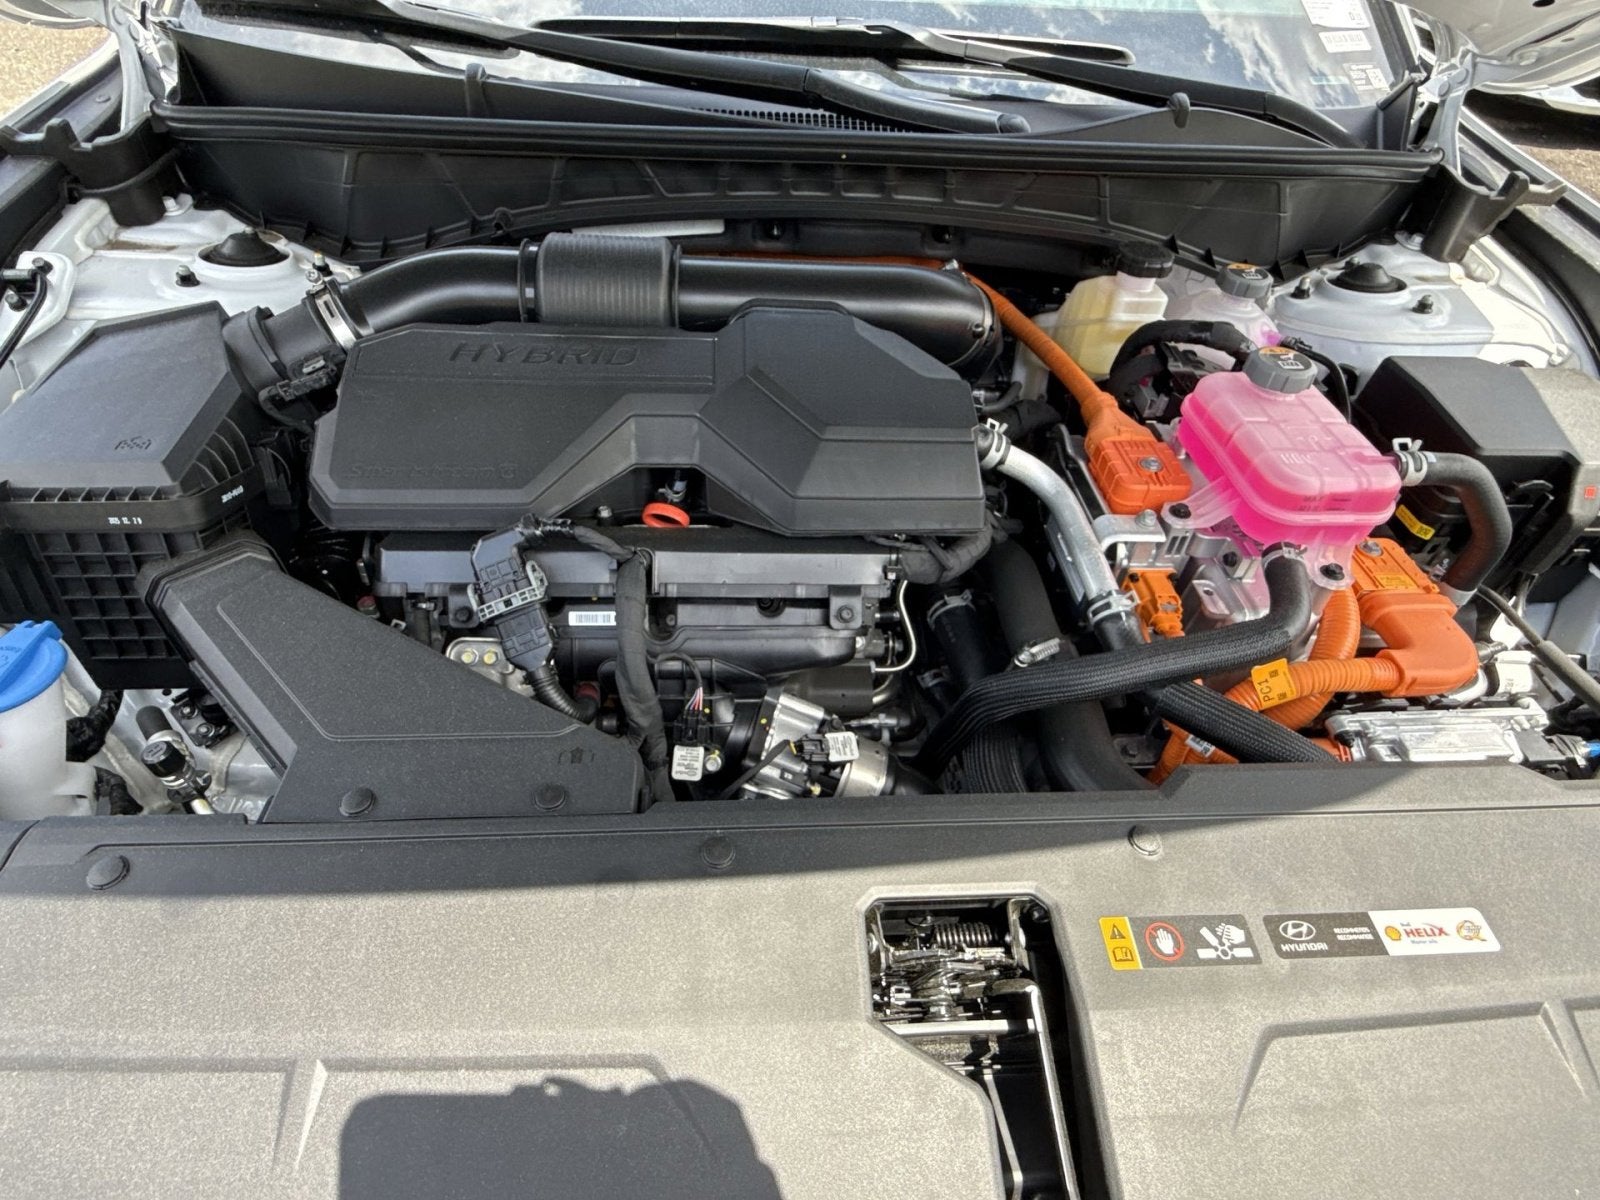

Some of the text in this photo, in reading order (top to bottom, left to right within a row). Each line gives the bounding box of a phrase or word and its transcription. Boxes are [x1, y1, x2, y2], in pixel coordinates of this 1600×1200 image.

[449, 342, 640, 365] HYBRID
[1257, 678, 1275, 703] PC1
[1403, 927, 1450, 938] HELIX
[1280, 942, 1329, 952] HYUNDAI
